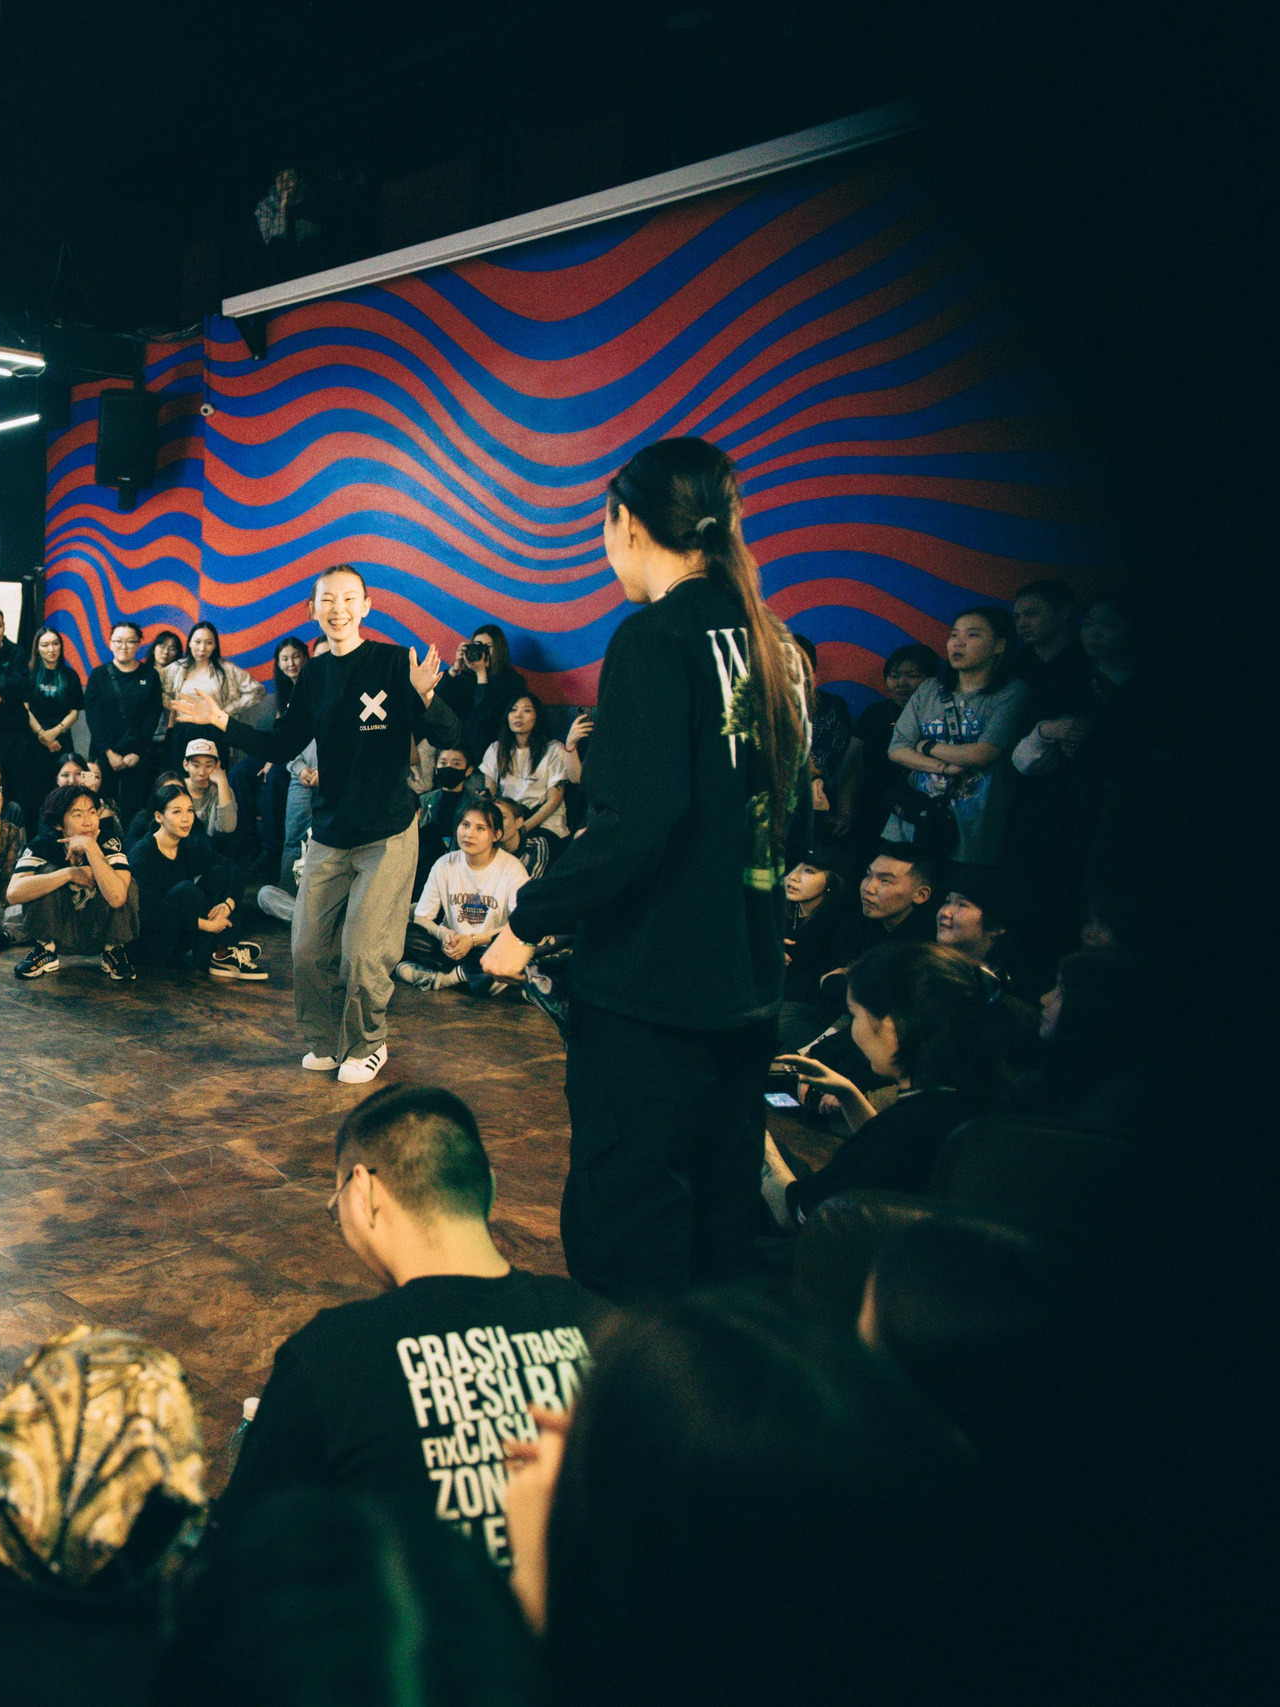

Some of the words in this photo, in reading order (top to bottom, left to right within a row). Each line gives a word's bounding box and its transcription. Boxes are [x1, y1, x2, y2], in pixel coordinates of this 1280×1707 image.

[396, 1325, 519, 1381] CRASH
[510, 1326, 591, 1366] TRASH
[408, 1369, 529, 1428] FRESH
[523, 1361, 586, 1415] BA
[429, 1462, 509, 1520] ZON
